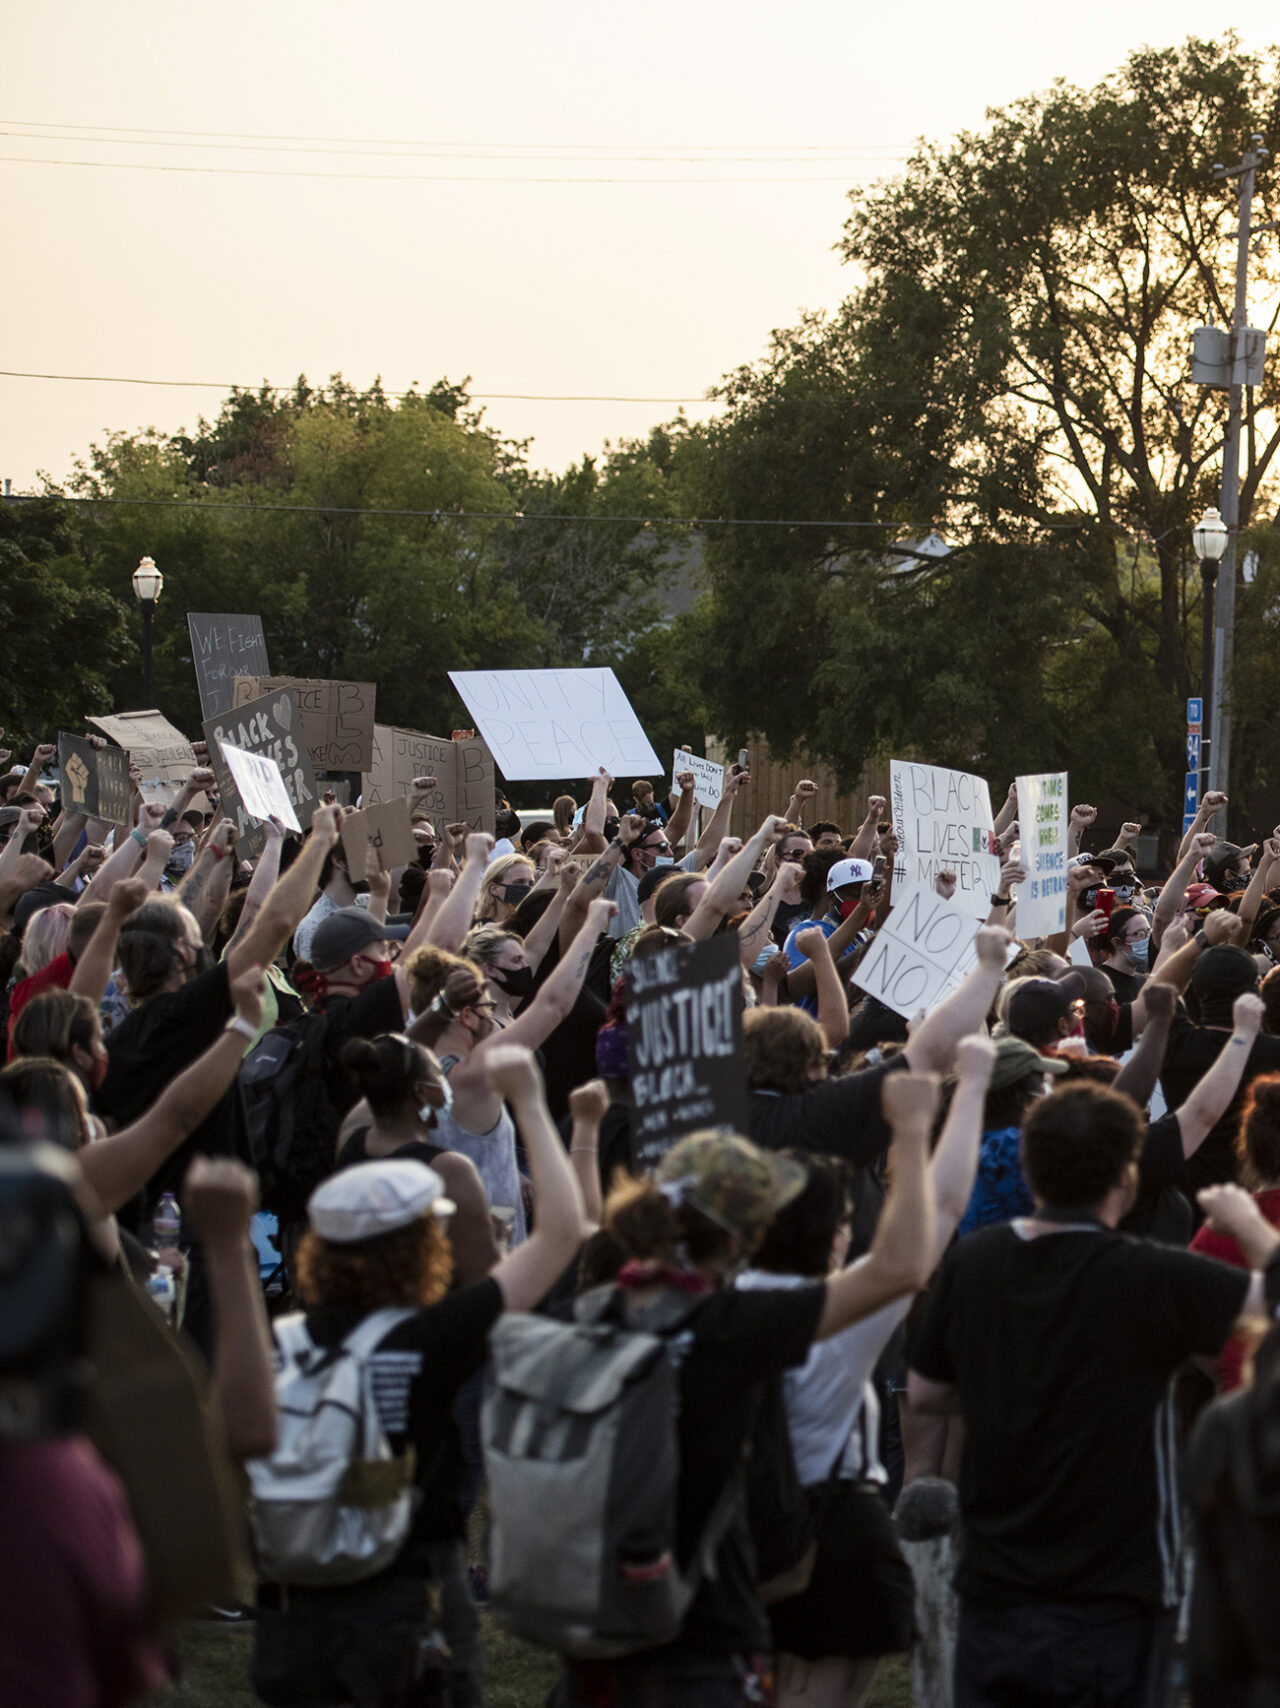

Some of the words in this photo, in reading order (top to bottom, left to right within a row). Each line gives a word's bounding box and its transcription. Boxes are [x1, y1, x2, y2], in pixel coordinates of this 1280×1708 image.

[459, 671, 606, 714] UNITY
[397, 739, 447, 763] JUSTICE
[482, 719, 652, 768] PEACE
[677, 753, 686, 764] All
[1188, 735, 1198, 762] 94
[708, 786, 720, 798] DO
[909, 765, 985, 818] BLACK
[917, 818, 970, 858] LIVES
[896, 892, 962, 954] NO
[865, 944, 929, 1007] NO
